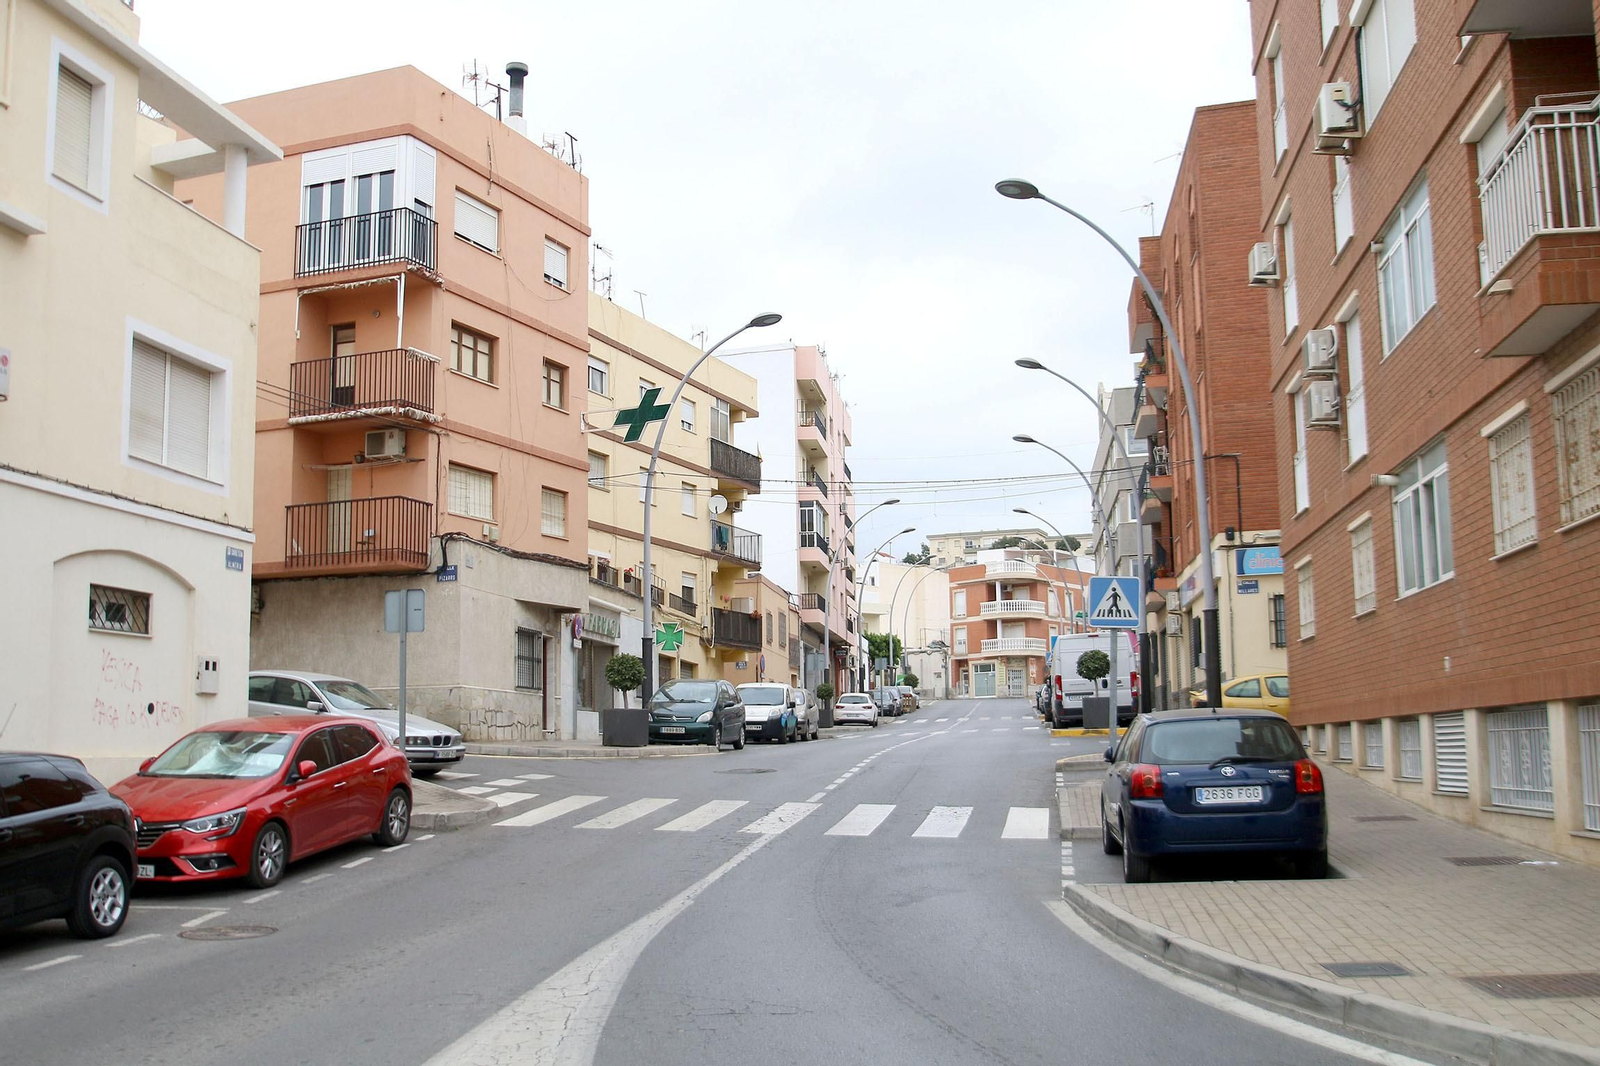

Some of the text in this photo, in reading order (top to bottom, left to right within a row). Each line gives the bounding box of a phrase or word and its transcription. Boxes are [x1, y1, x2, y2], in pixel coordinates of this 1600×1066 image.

[589, 612, 620, 638] FARMACIA
[1204, 787, 1260, 800] 2636 FGG
